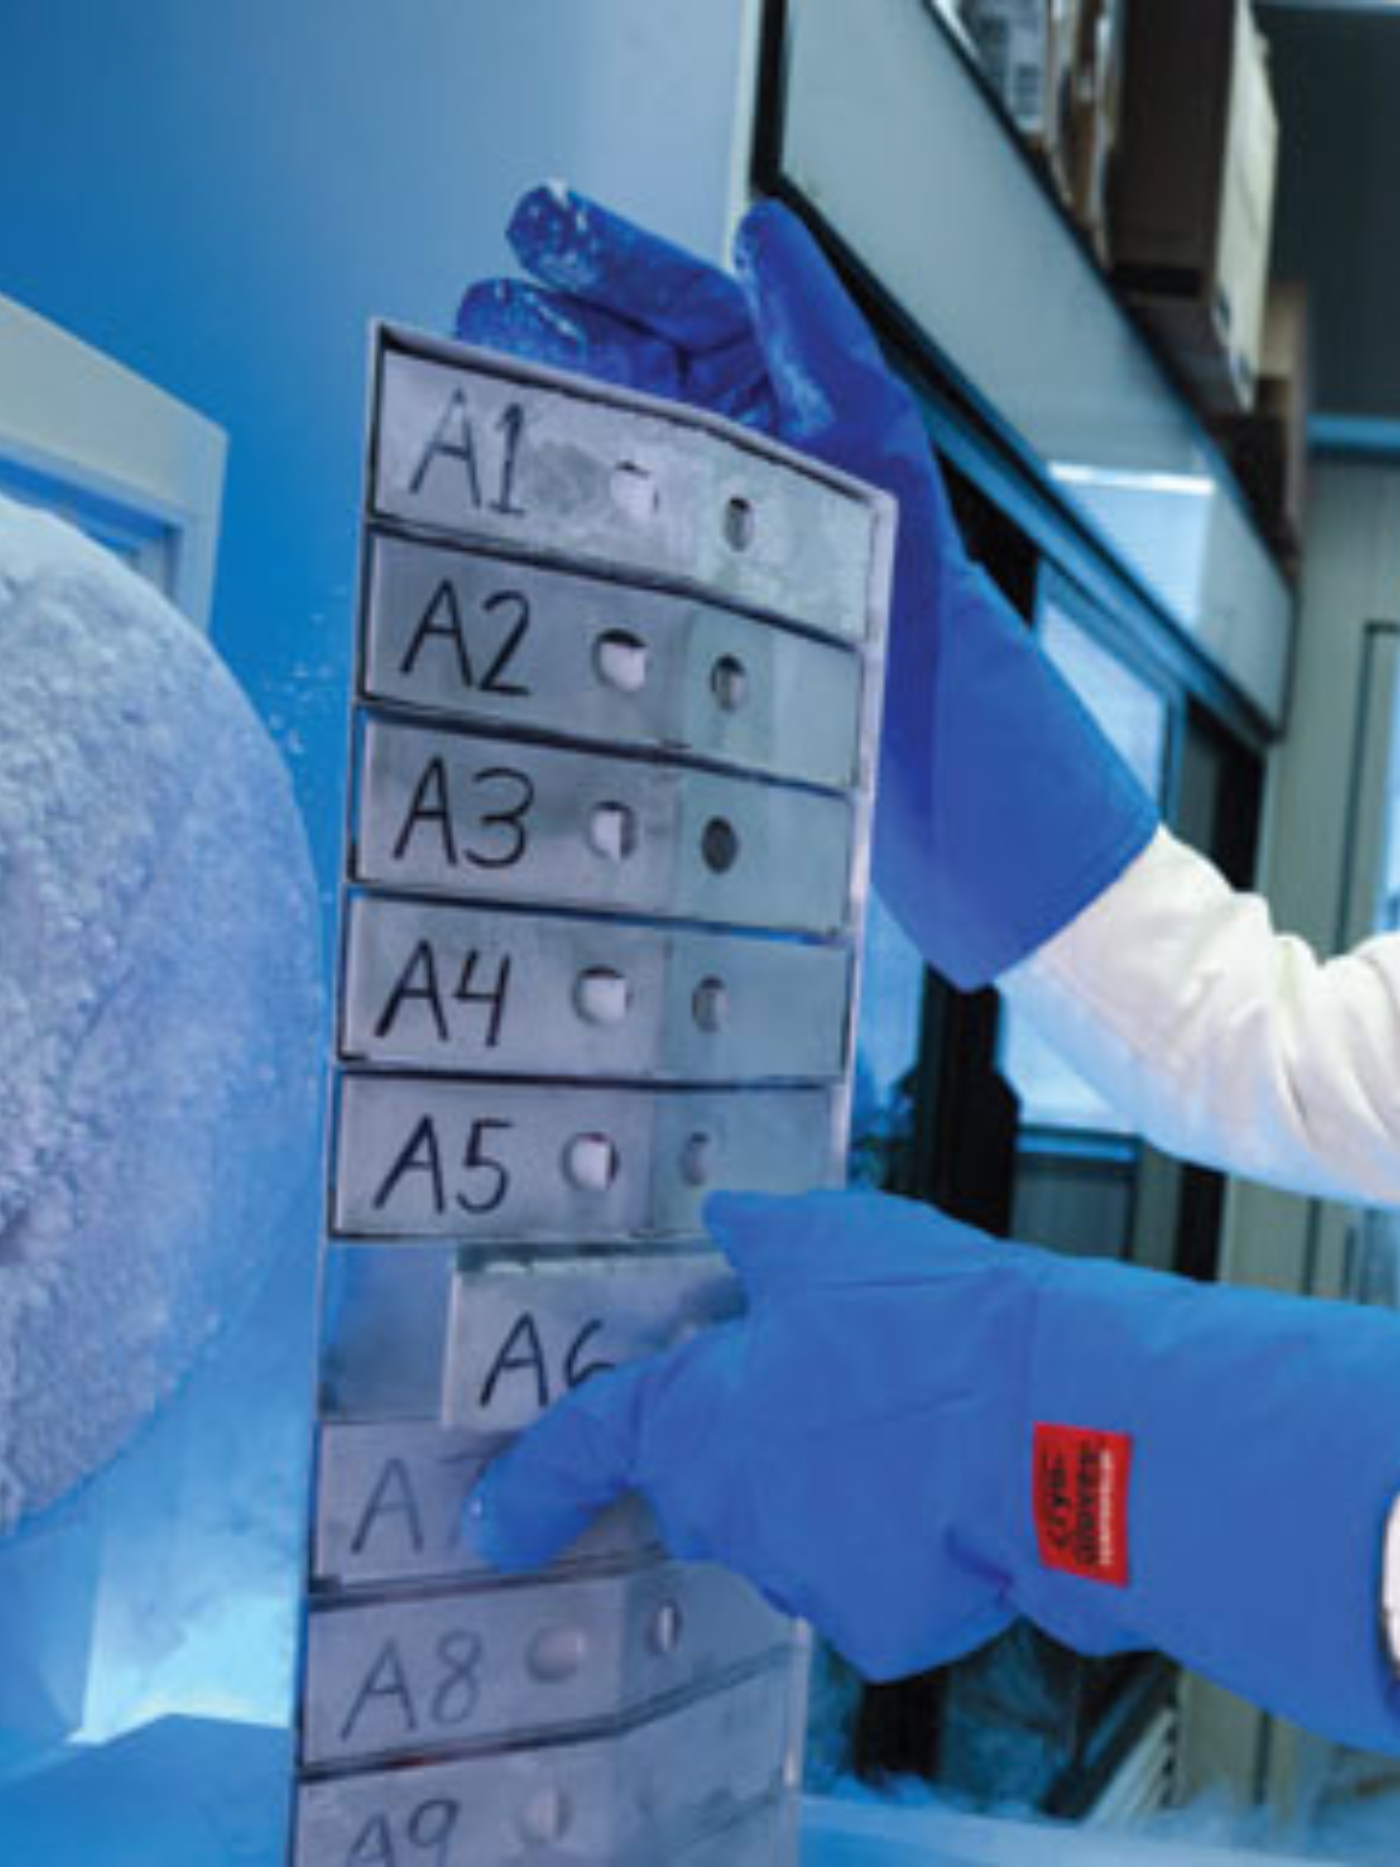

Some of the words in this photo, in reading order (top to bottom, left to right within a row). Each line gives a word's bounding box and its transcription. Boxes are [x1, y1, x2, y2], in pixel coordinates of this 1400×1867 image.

[408, 388, 525, 517] A1
[400, 579, 532, 696] A2
[392, 755, 535, 869] A3
[373, 939, 512, 1047] A4
[372, 1113, 515, 1215] A5
[339, 1631, 483, 1742] A8
